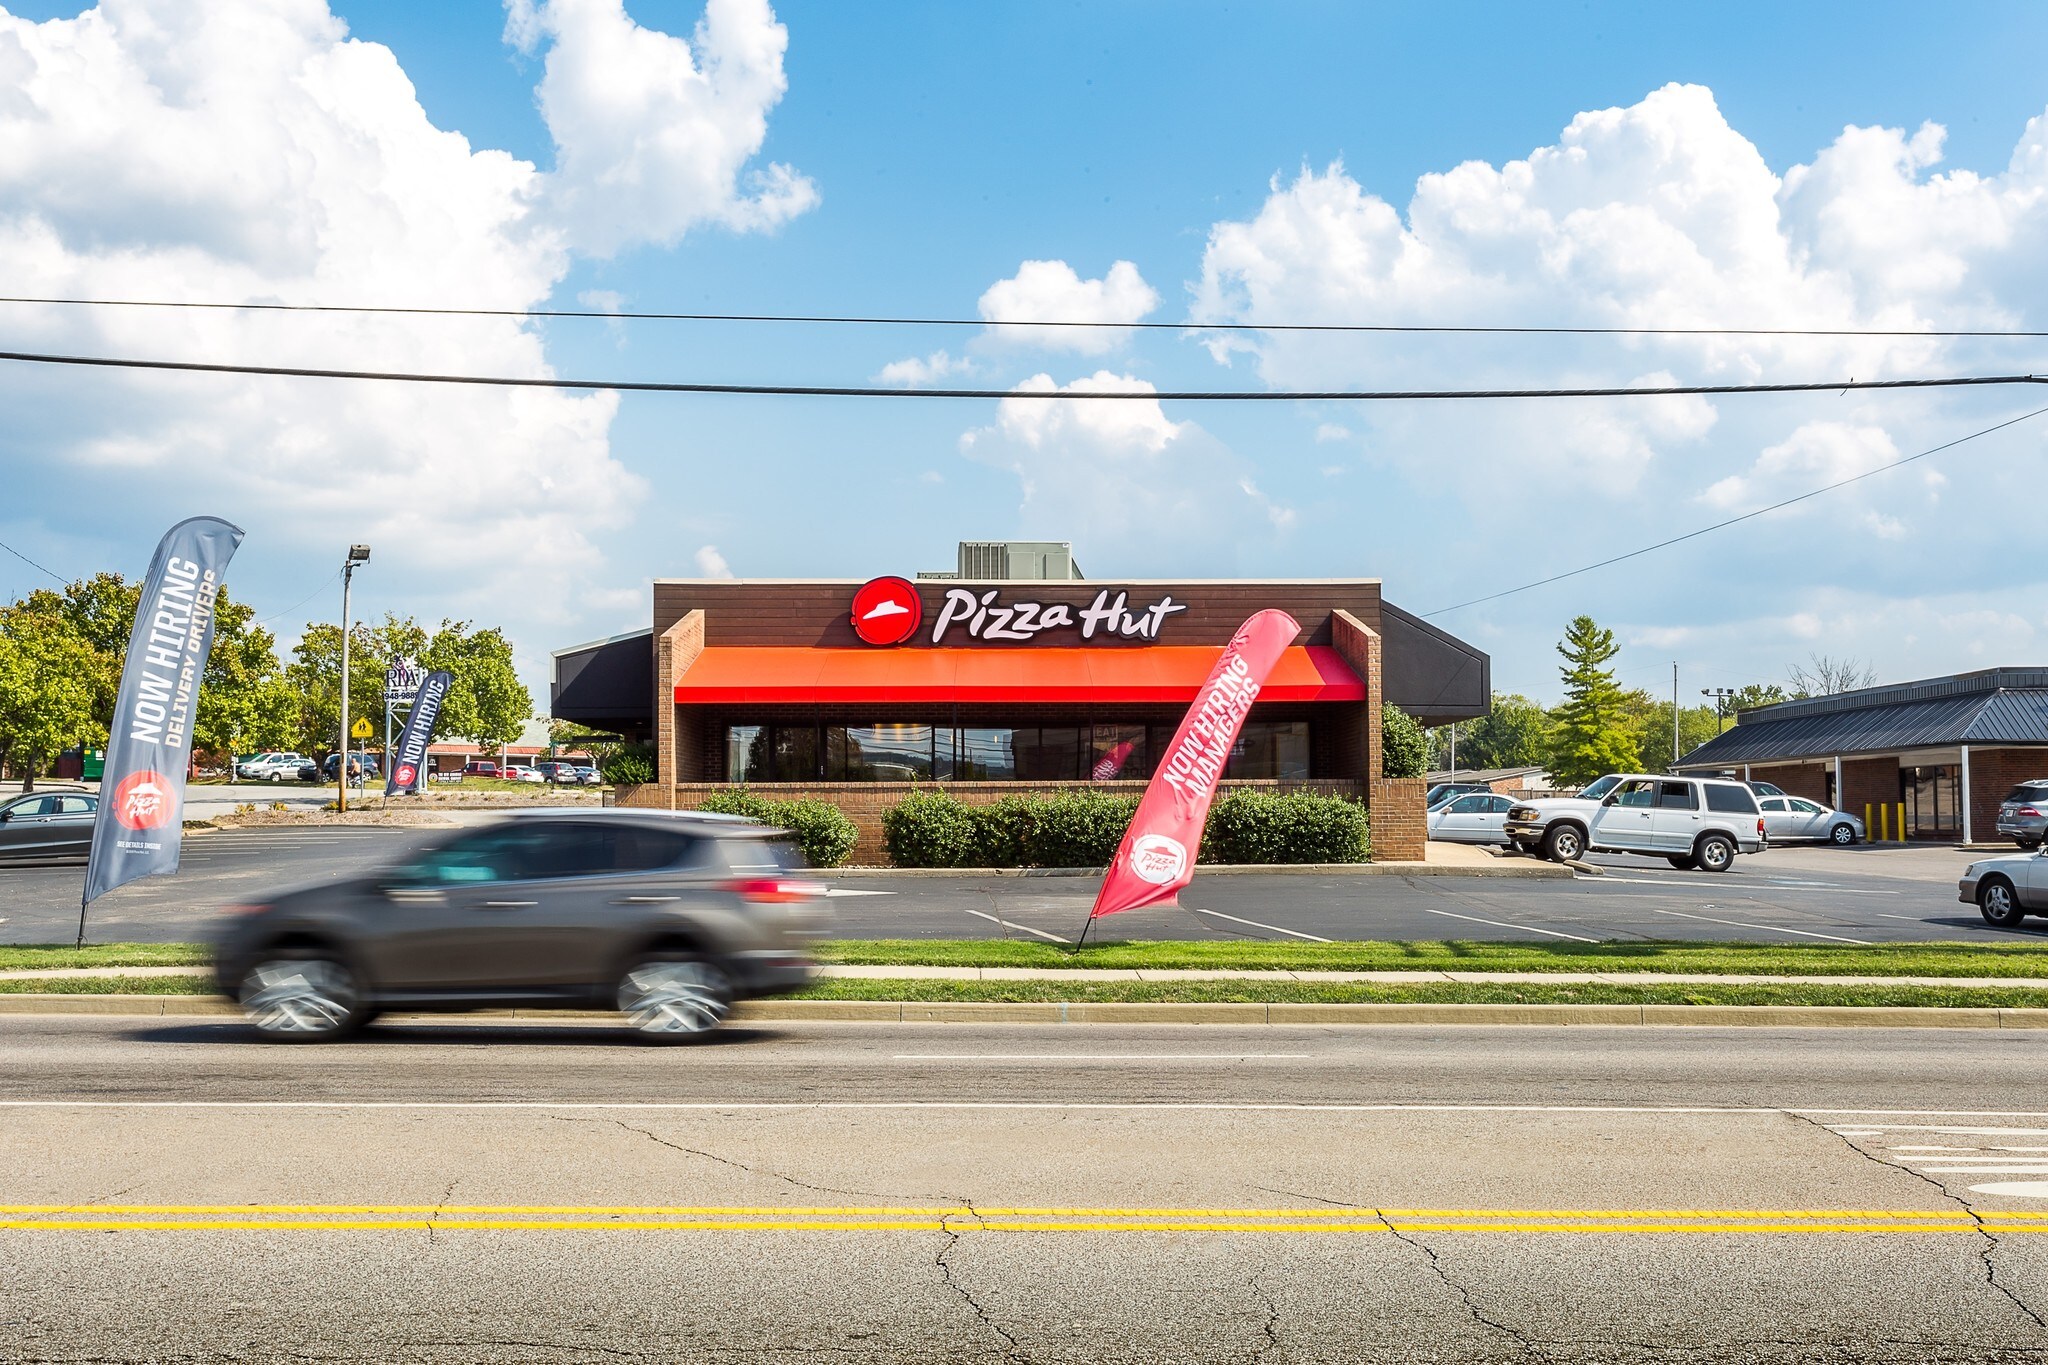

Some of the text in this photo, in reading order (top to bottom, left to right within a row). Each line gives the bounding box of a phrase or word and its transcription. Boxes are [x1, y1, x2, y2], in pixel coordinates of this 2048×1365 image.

[130, 557, 199, 744] NOW HIRING
[932, 588, 1186, 643] Pizza Hut
[165, 569, 216, 748] DELIVERY DRIVERS
[402, 729, 426, 765] NOW
[415, 680, 445, 730] HIRING
[1163, 653, 1248, 790] NOW HIRING
[1185, 677, 1260, 798] MANAGERS
[125, 794, 160, 810] Pizza
[129, 805, 159, 818] Hut
[1141, 853, 1176, 865] Pizza
[1146, 863, 1169, 871] Hut
